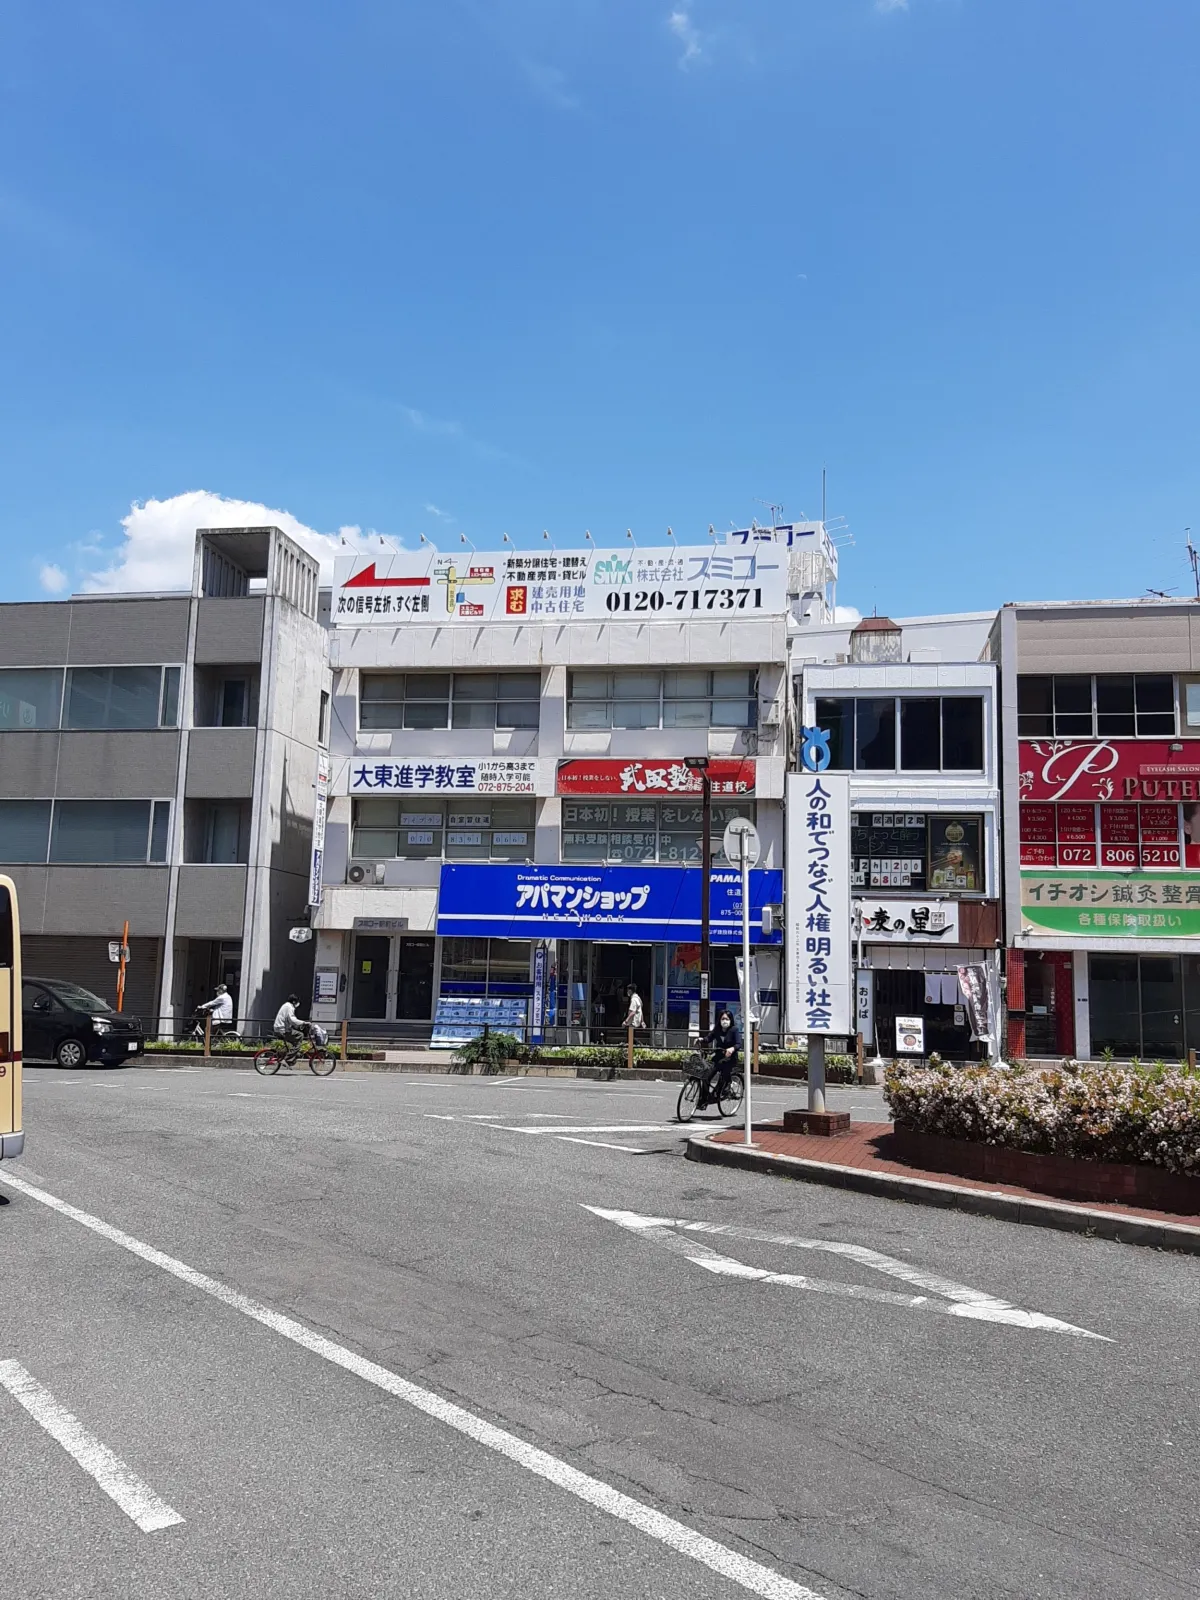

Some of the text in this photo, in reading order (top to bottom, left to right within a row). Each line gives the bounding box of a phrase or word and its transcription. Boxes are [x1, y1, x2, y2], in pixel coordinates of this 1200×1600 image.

[637, 567, 684, 583] 株式会社
[687, 555, 779, 581] スミコー
[531, 585, 586, 599] 建売用地
[337, 594, 430, 614] 次の信号左折、すぐ左側
[509, 588, 524, 613] 求む
[530, 600, 585, 614] 中古住宅
[606, 588, 763, 613] 0120-717371
[478, 762, 536, 771] 小1から高3まで
[352, 764, 476, 789] 大東進学教室
[480, 773, 531, 782] 随時入学可能
[619, 763, 689, 792] 武田塾
[478, 783, 535, 792] 072-875-2041
[410, 836, 526, 844] 070 8391 0667
[564, 834, 672, 846] 無料受験相談受付中
[1062, 848, 1180, 862] 072 806 5210
[515, 883, 651, 911] アパマンショップ
[1078, 913, 1182, 927] 各種保険取扱い
[805, 936, 833, 1030] 明るい社会
[858, 987, 869, 1019] おりば
